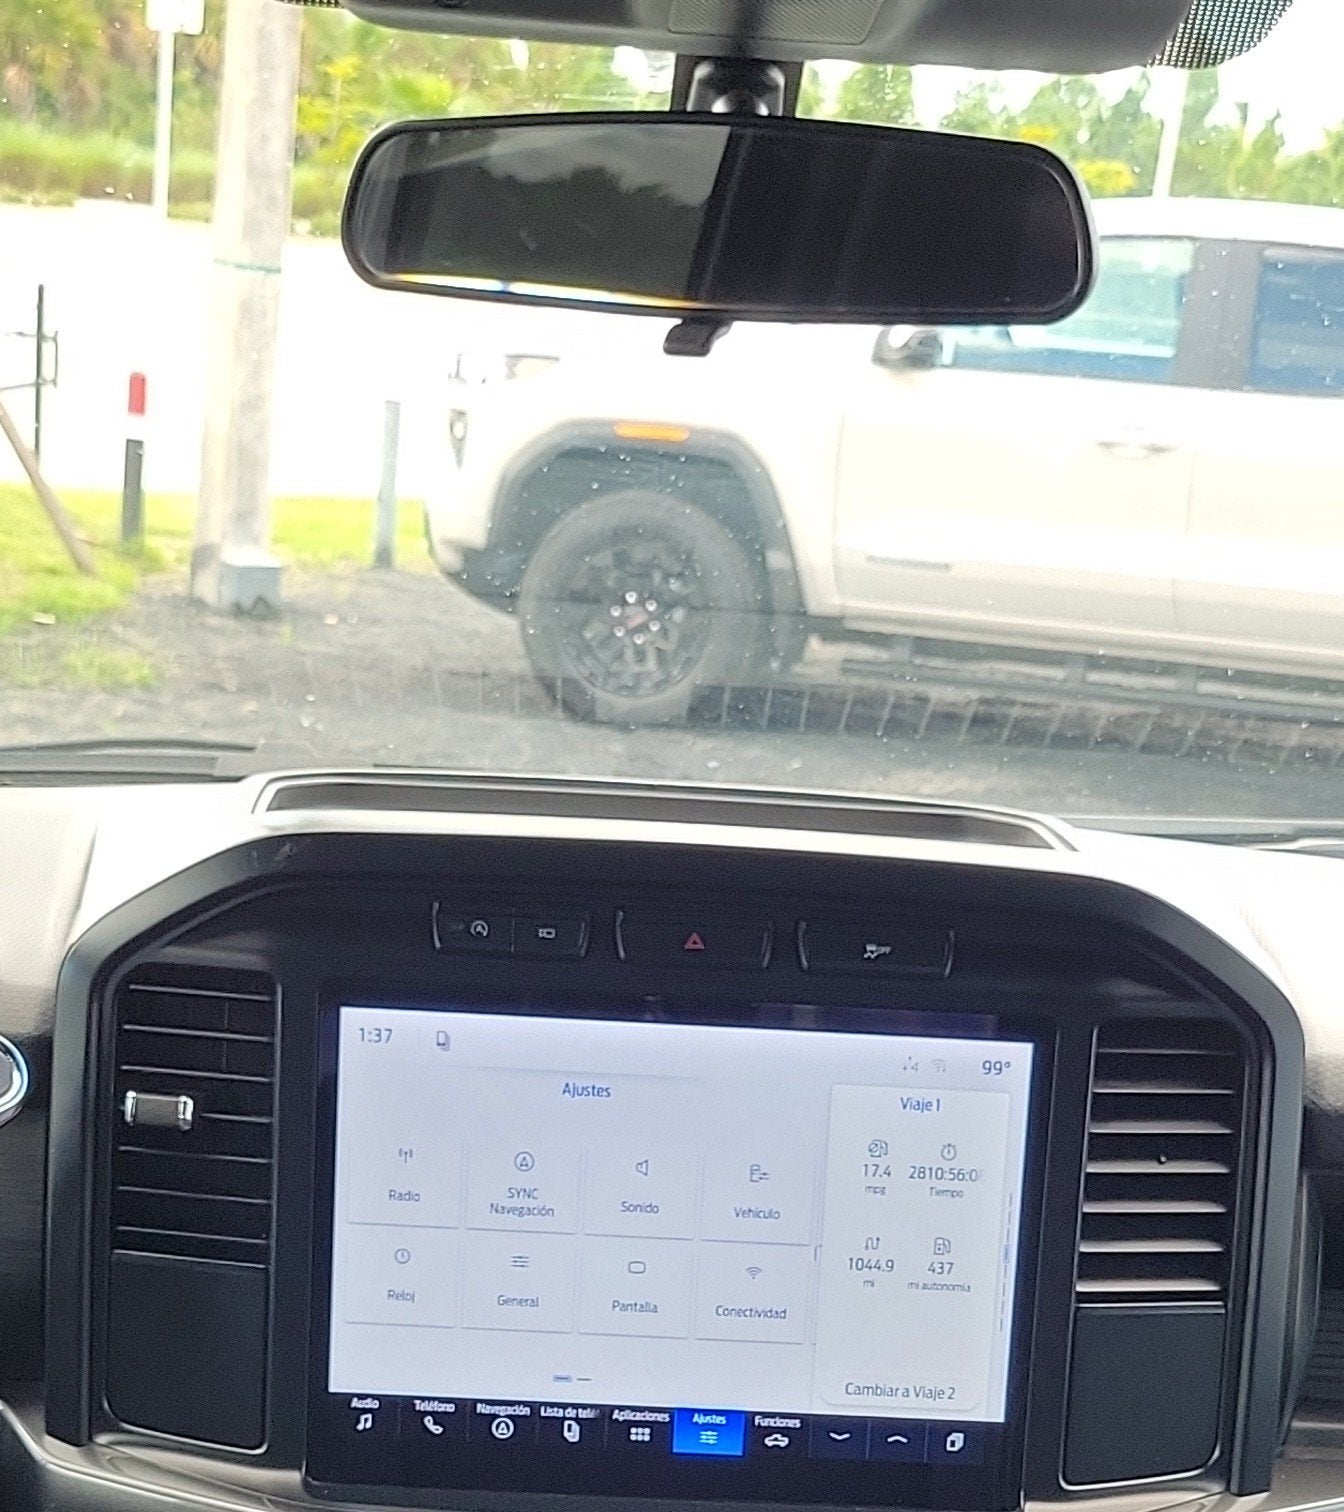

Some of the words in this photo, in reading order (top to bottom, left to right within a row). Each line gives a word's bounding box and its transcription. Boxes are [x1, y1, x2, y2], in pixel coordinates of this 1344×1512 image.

[358, 1028, 393, 1043] 1:37
[562, 1082, 611, 1098] Ajustes
[900, 1097, 932, 1113] Viaje
[936, 1098, 941, 1112] 1
[863, 1164, 892, 1177] 17.4
[389, 1190, 420, 1203] Radio
[508, 1187, 538, 1200] SYNC
[929, 1187, 963, 1198] Tiempo
[490, 1203, 554, 1218] Navegación
[621, 1201, 659, 1214] Sonido
[849, 1258, 894, 1273] 1044.9
[927, 1262, 954, 1275] 437
[863, 1279, 875, 1288] mi
[907, 1281, 919, 1290] mi
[388, 1290, 415, 1304] Reloj
[497, 1295, 539, 1307] General
[612, 1300, 658, 1313] Pantalla
[715, 1305, 787, 1319] Conectividad
[845, 1382, 899, 1397] Cambiar
[901, 1387, 910, 1398] a
[913, 1386, 945, 1401] Viaje
[948, 1387, 956, 1399] 2
[351, 1397, 379, 1409] Audio
[476, 1403, 531, 1416] Navegación
[564, 1407, 577, 1418] de
[612, 1409, 670, 1423] Aplicaciones
[692, 1413, 727, 1426] Ajustes
[754, 1416, 801, 1429] Funciones
